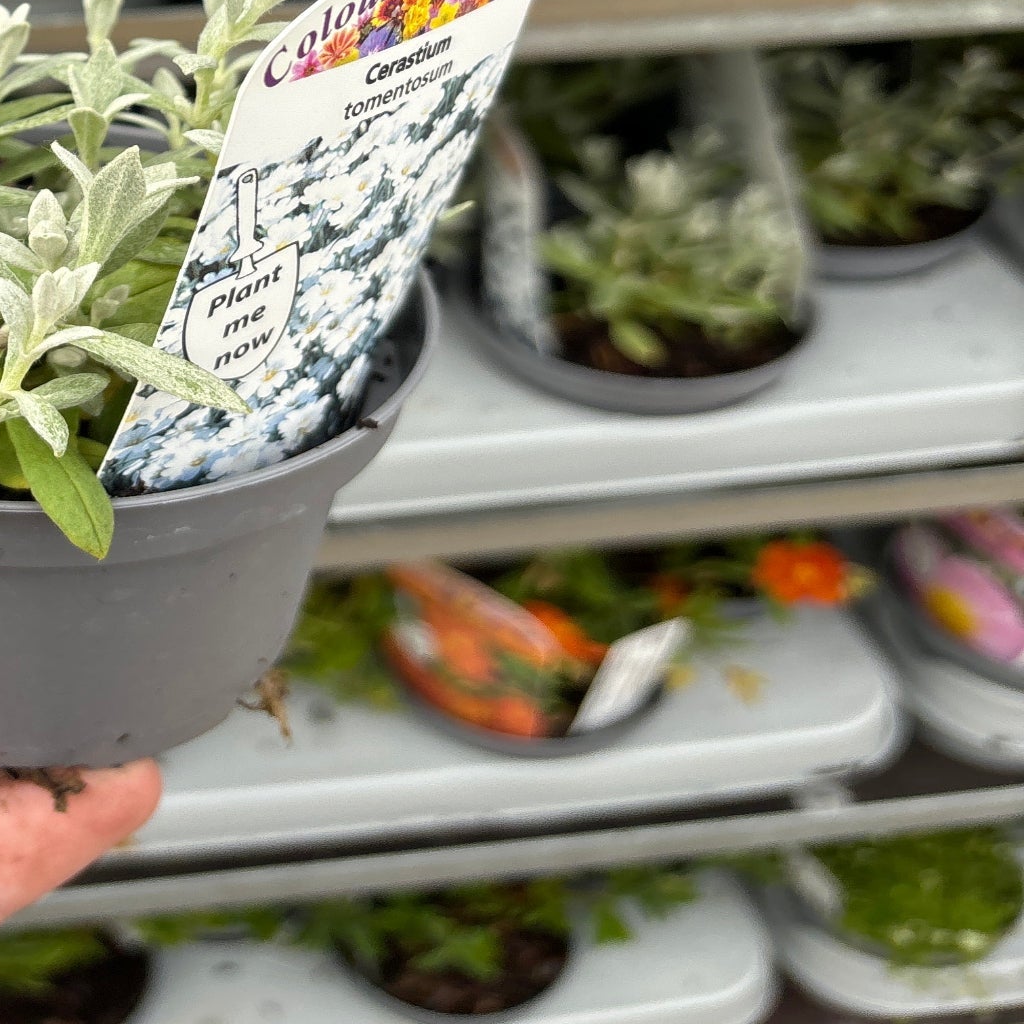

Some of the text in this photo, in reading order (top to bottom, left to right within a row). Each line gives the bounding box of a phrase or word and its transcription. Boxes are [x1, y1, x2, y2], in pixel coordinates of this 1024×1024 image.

[365, 34, 453, 85] Cerastium
[343, 58, 454, 120] tomentosum
[207, 264, 283, 318] Plant
[222, 305, 266, 338] me
[213, 326, 276, 370] now
